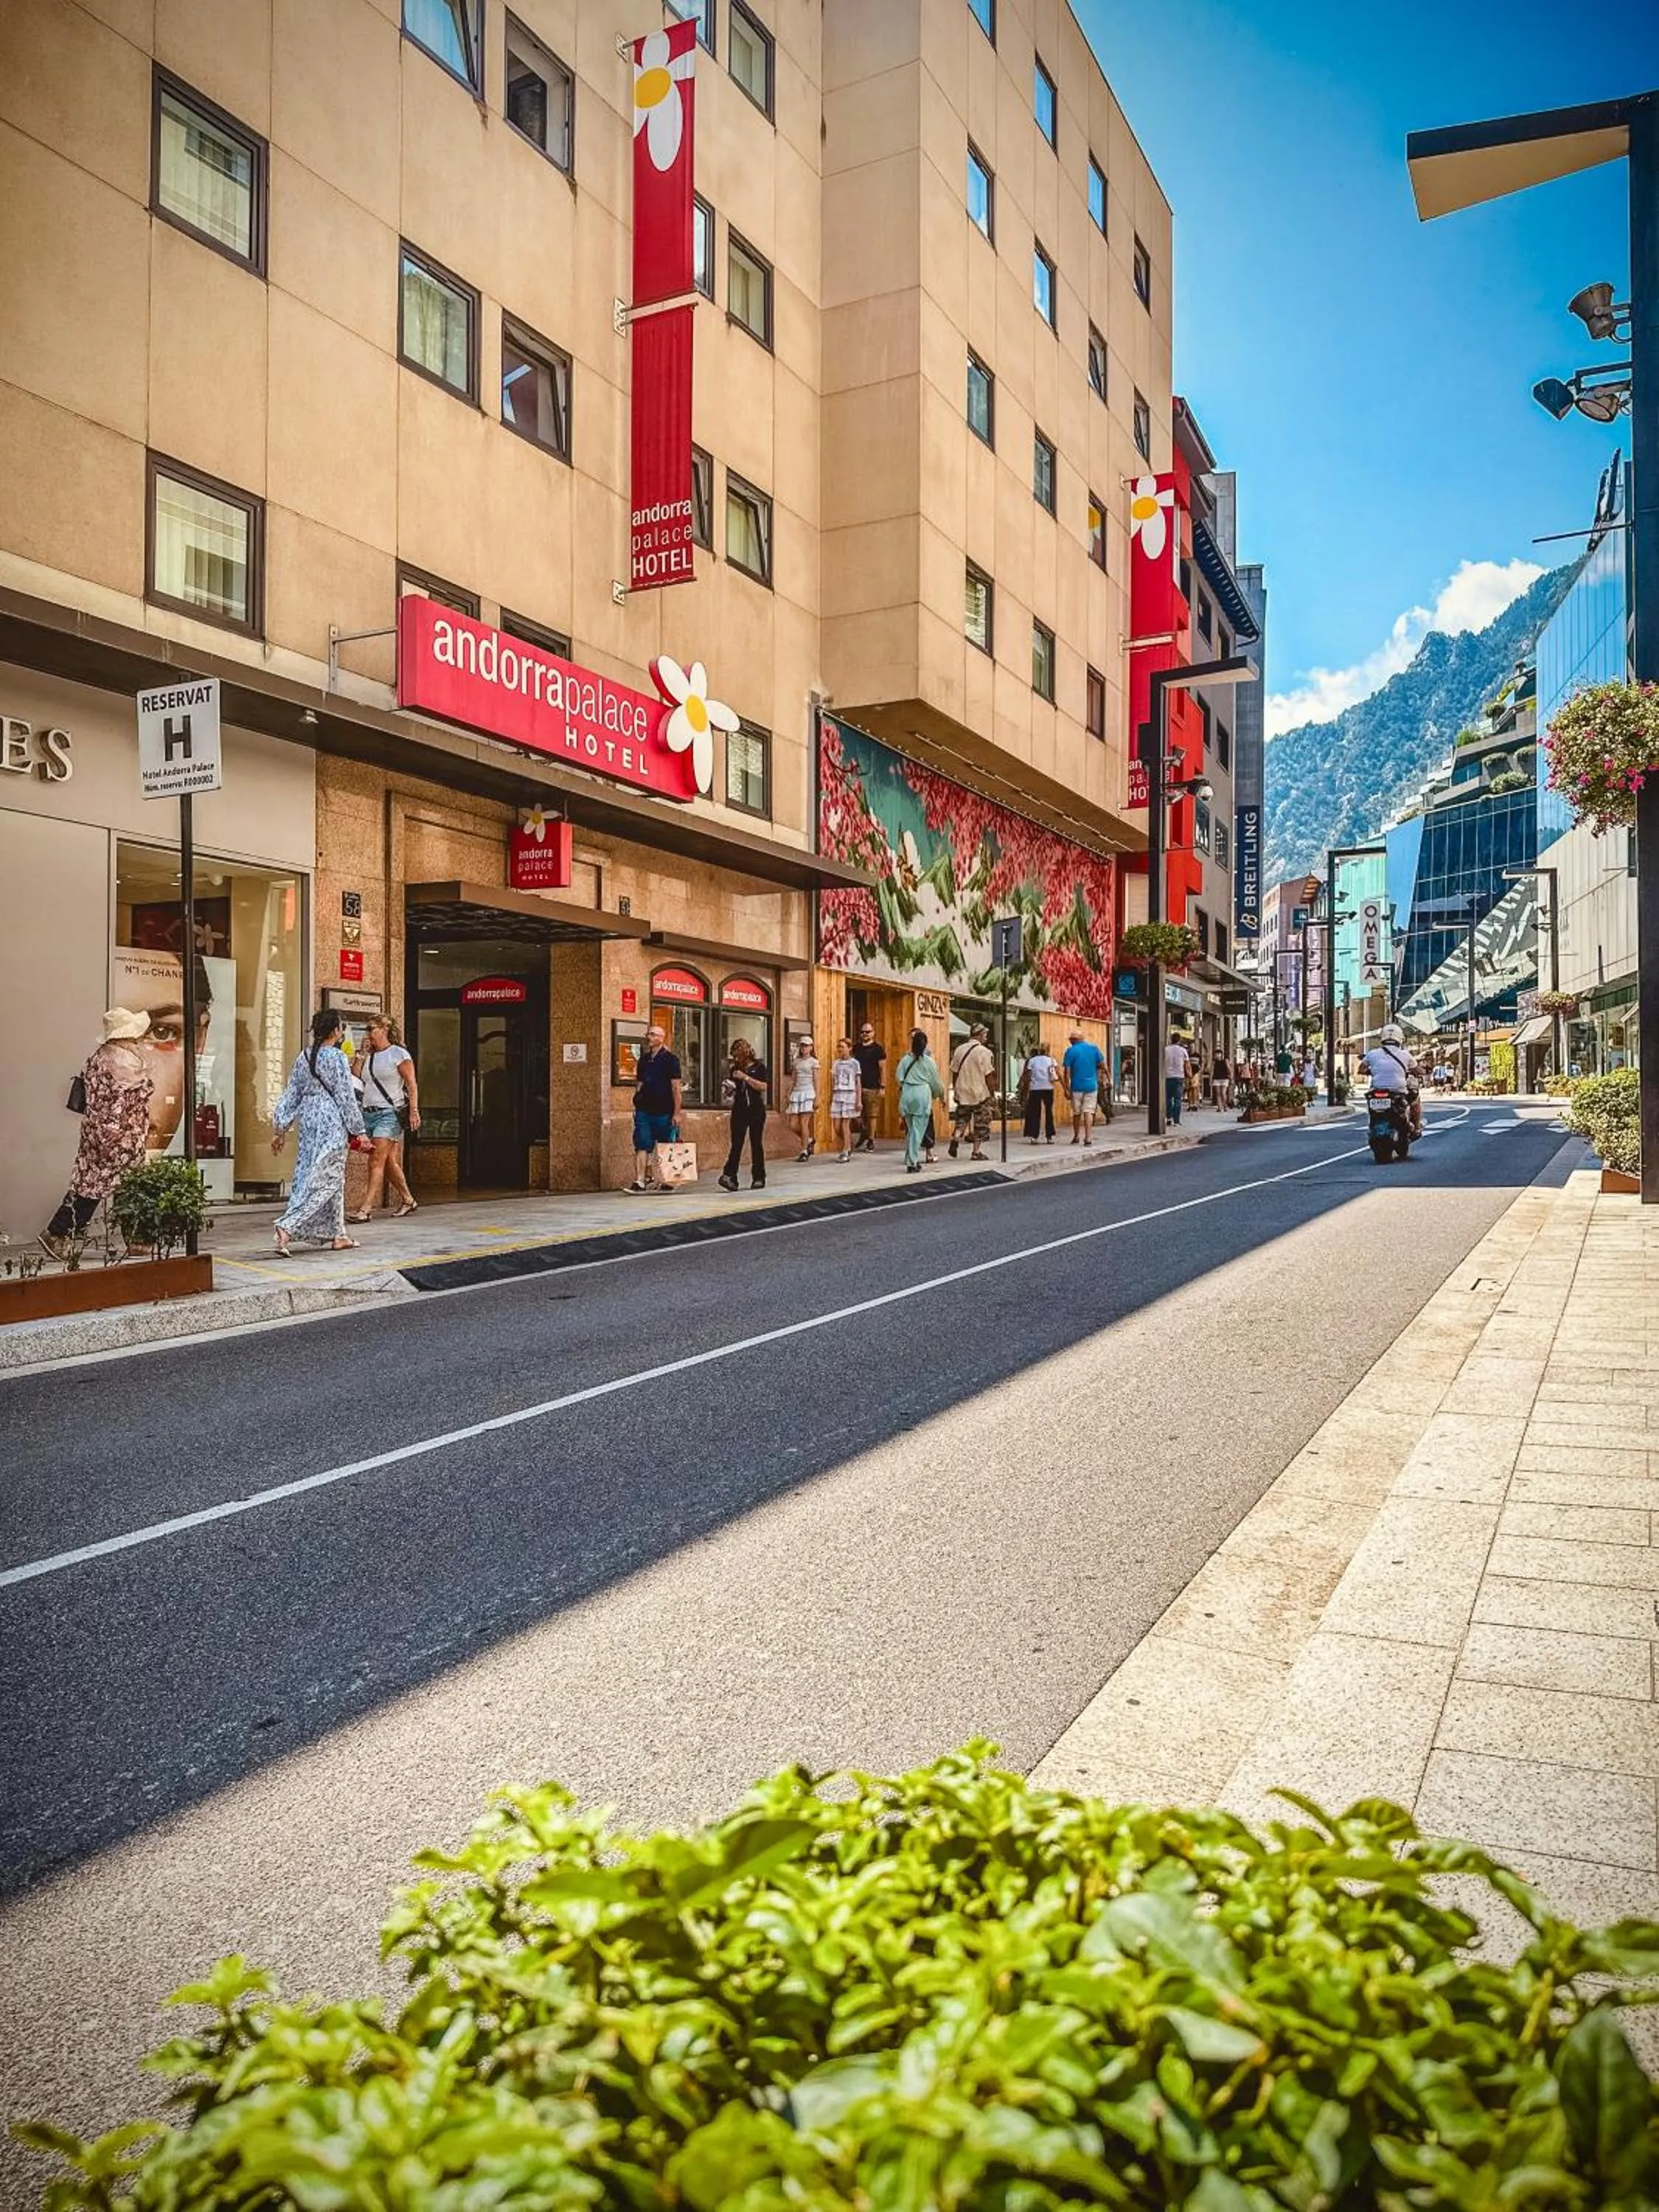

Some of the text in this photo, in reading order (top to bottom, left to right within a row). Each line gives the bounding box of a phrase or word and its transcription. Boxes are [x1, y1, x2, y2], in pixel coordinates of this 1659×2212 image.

[632, 499, 692, 526] andorra
[632, 524, 692, 555] palace
[632, 547, 692, 579] HOTEL
[433, 619, 647, 742] andorrapalace
[142, 686, 212, 713] RESERVAT
[164, 714, 192, 762] H
[565, 726, 648, 774] HOTEL
[142, 762, 215, 779] Hotel Andorra Palace
[518, 848, 553, 860] andorra
[518, 860, 553, 873] palace
[1244, 812, 1257, 908] BREITLING
[1364, 905, 1378, 980] OMEGA
